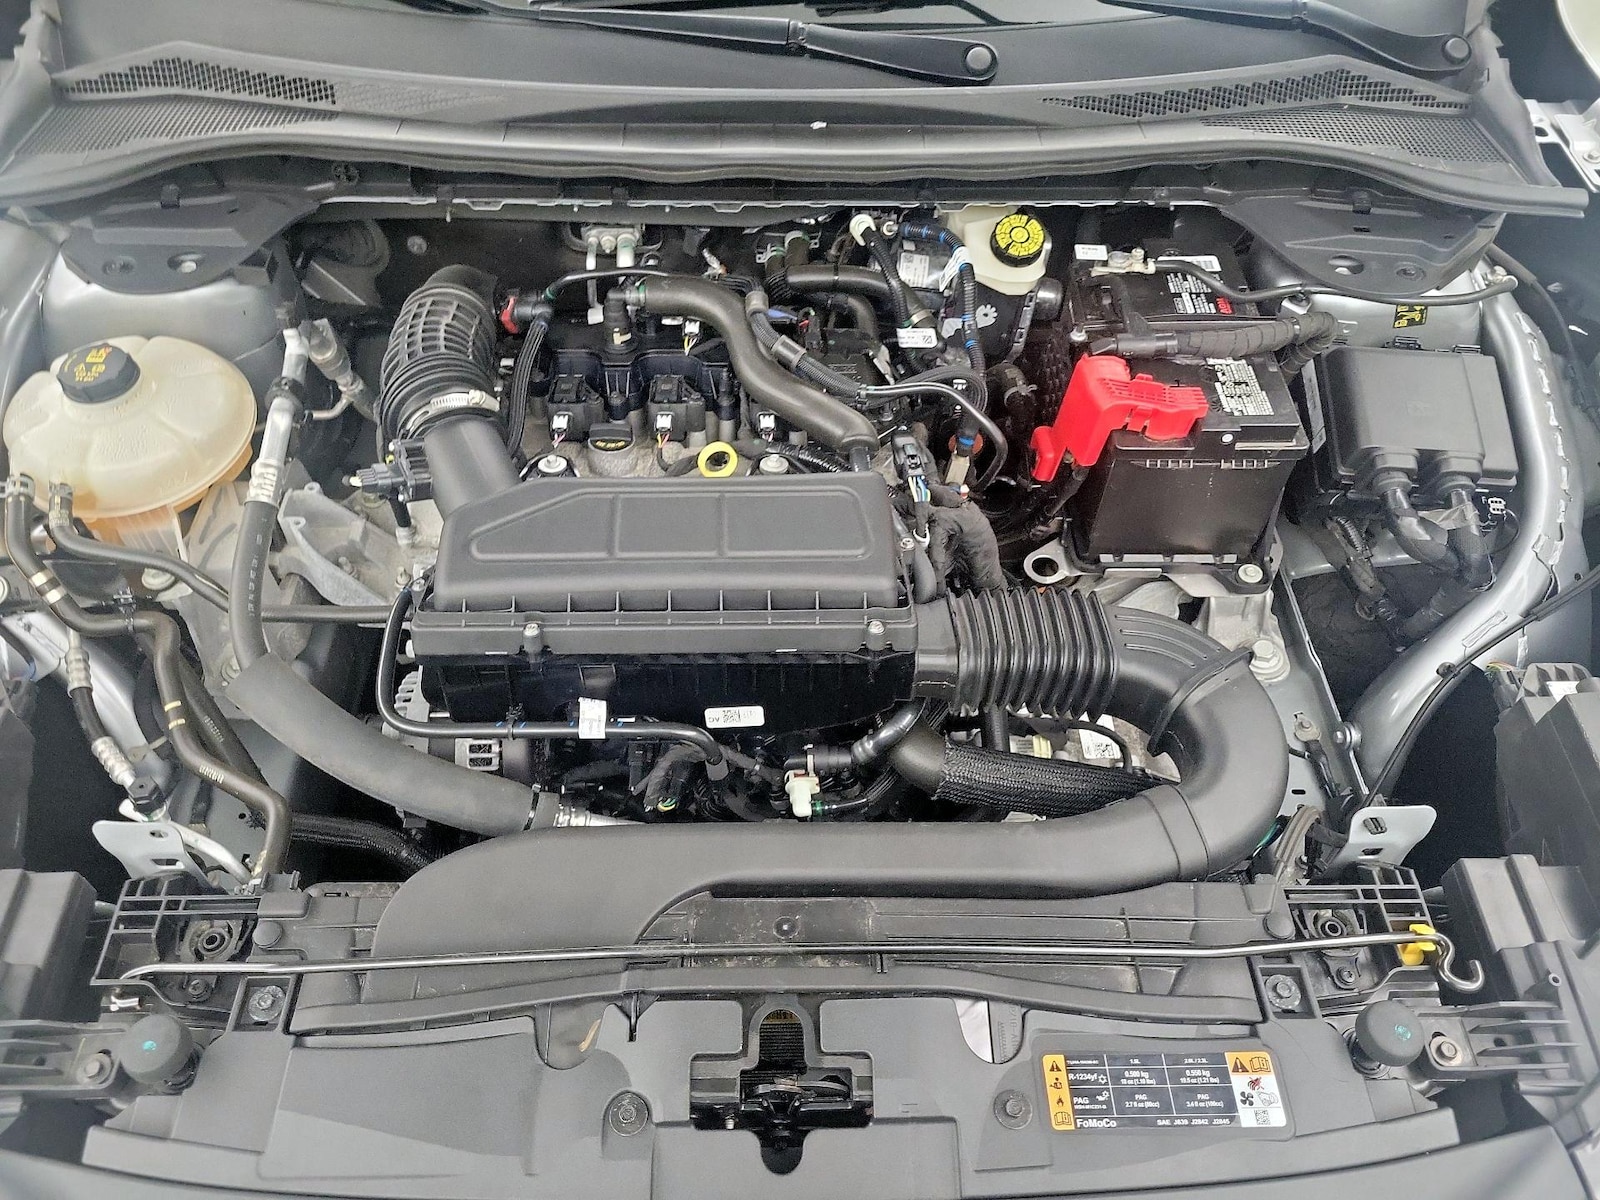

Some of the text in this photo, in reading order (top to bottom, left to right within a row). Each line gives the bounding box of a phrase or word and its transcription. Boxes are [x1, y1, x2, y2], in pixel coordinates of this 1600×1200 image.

[1140, 1070, 1149, 1078] kg
[1202, 1069, 1210, 1077] kg
[1068, 1073, 1098, 1082] R-1234yf
[1073, 1096, 1089, 1104] PAG
[1076, 1118, 1117, 1128] FoMoCo
